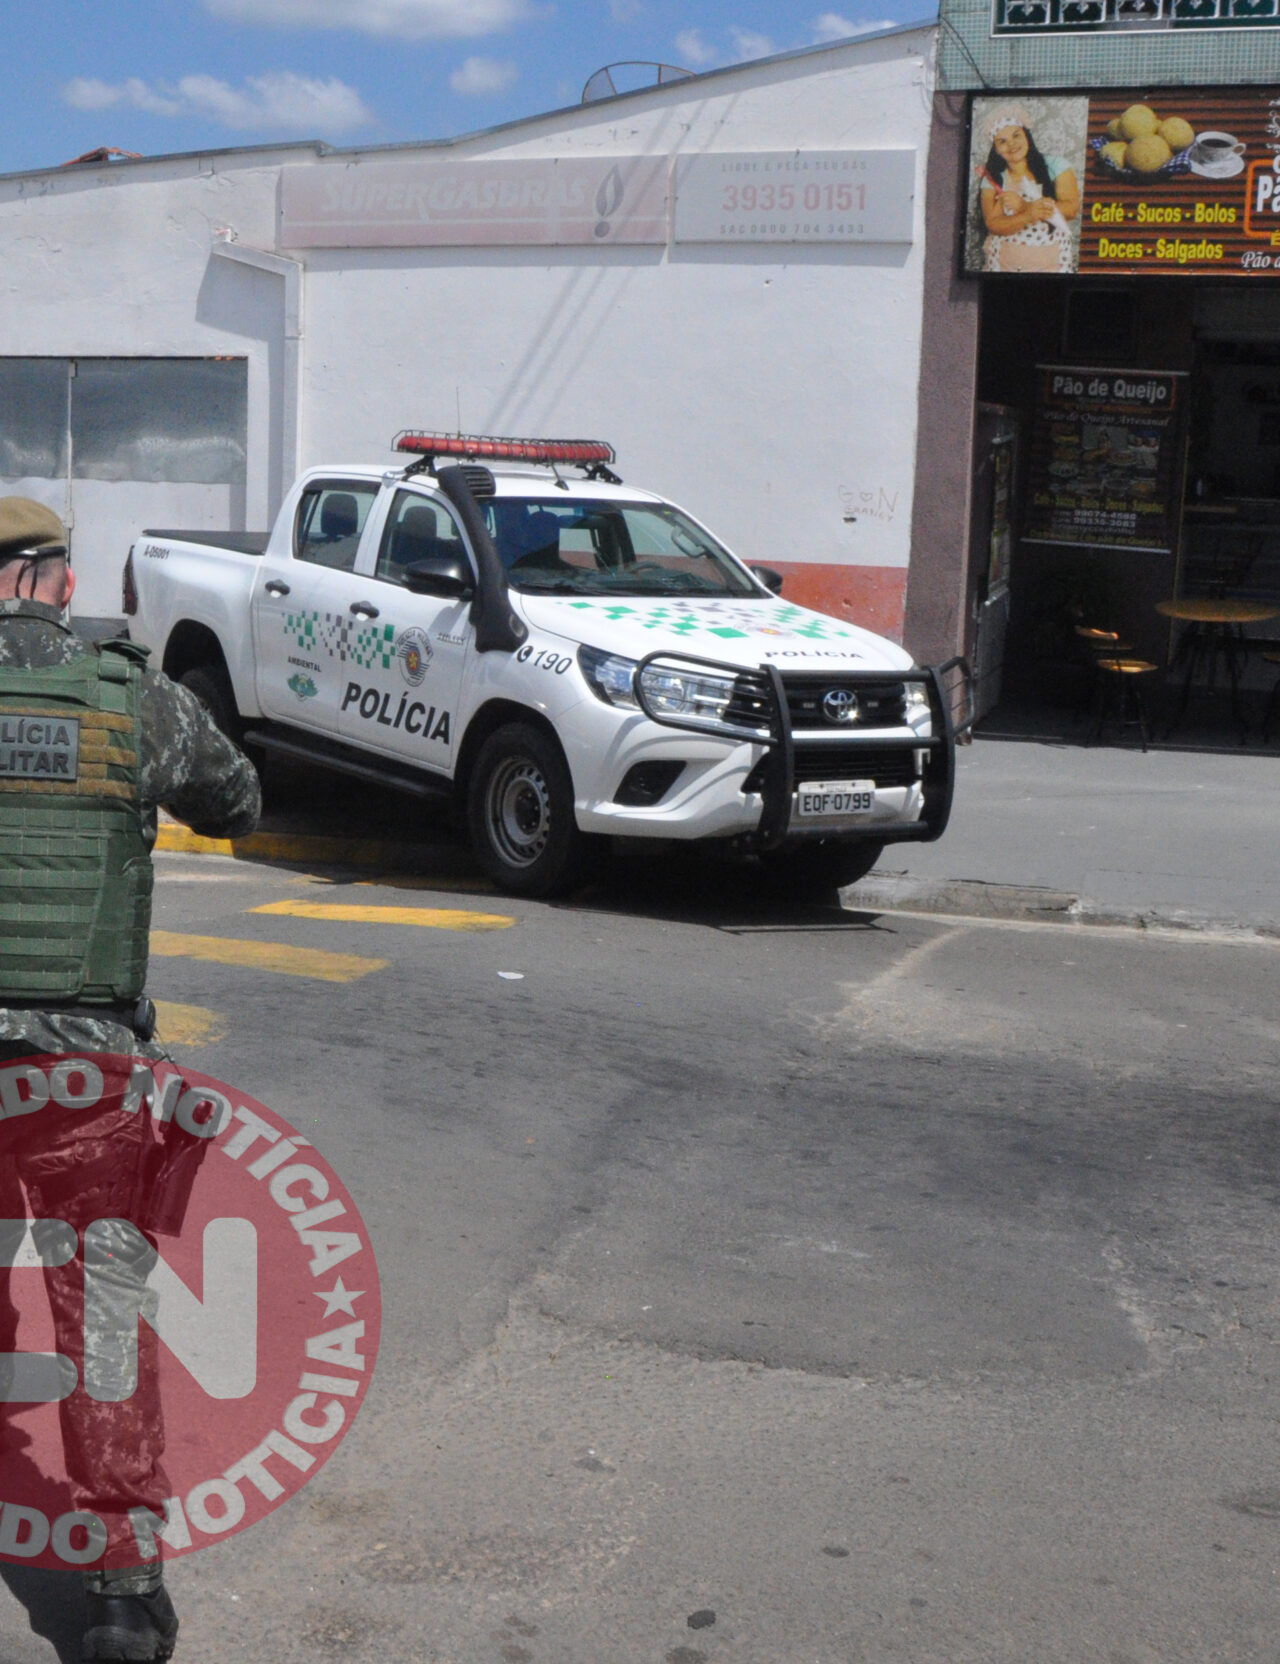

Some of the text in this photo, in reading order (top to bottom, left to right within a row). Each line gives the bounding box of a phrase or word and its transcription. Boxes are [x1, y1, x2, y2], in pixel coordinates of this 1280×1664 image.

[722, 182, 867, 211] 3935 0151
[1091, 202, 1236, 223] Café Sucos Bolos
[720, 224, 746, 234] SAC
[794, 223, 820, 234] 704
[1098, 238, 1224, 264] Doces Salgados
[1241, 251, 1271, 268] Pão
[1052, 375, 1167, 404] Pão de Queijo
[287, 655, 322, 673] AMBIENTAL
[534, 650, 573, 675] 190
[341, 682, 451, 745] POLÍCIA
